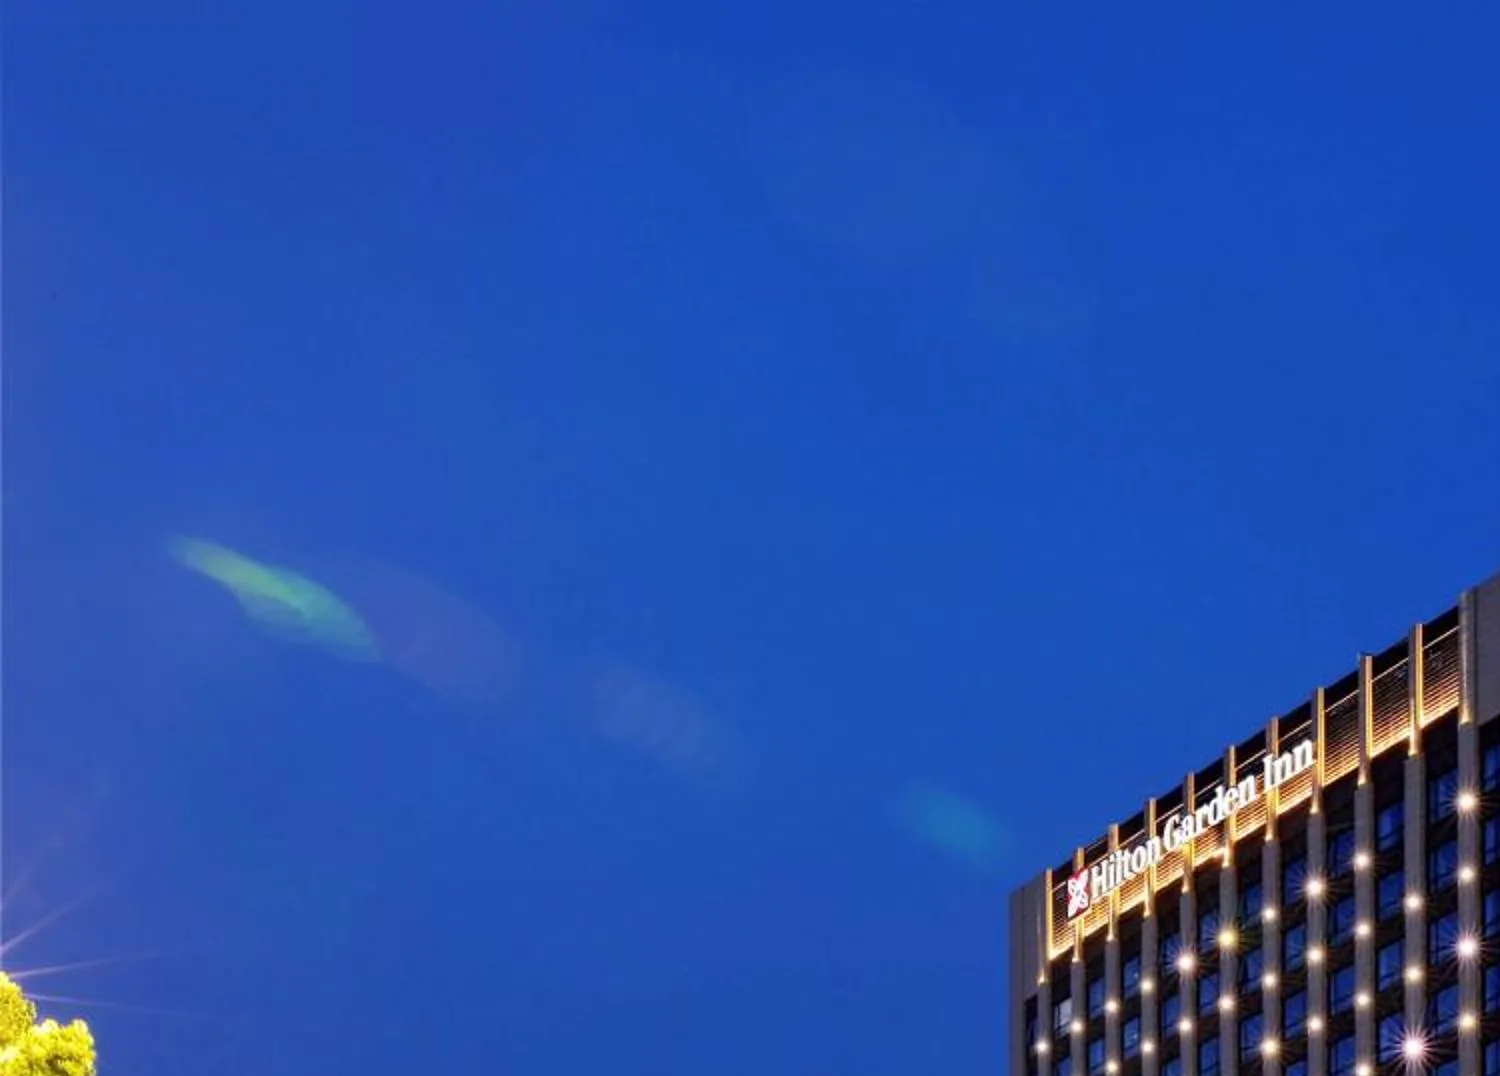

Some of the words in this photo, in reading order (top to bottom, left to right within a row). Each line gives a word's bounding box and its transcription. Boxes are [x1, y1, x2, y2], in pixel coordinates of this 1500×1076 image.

[1089, 838, 1162, 902] Hilton
[1163, 775, 1258, 852] Garden
[1262, 738, 1314, 791] Inn
